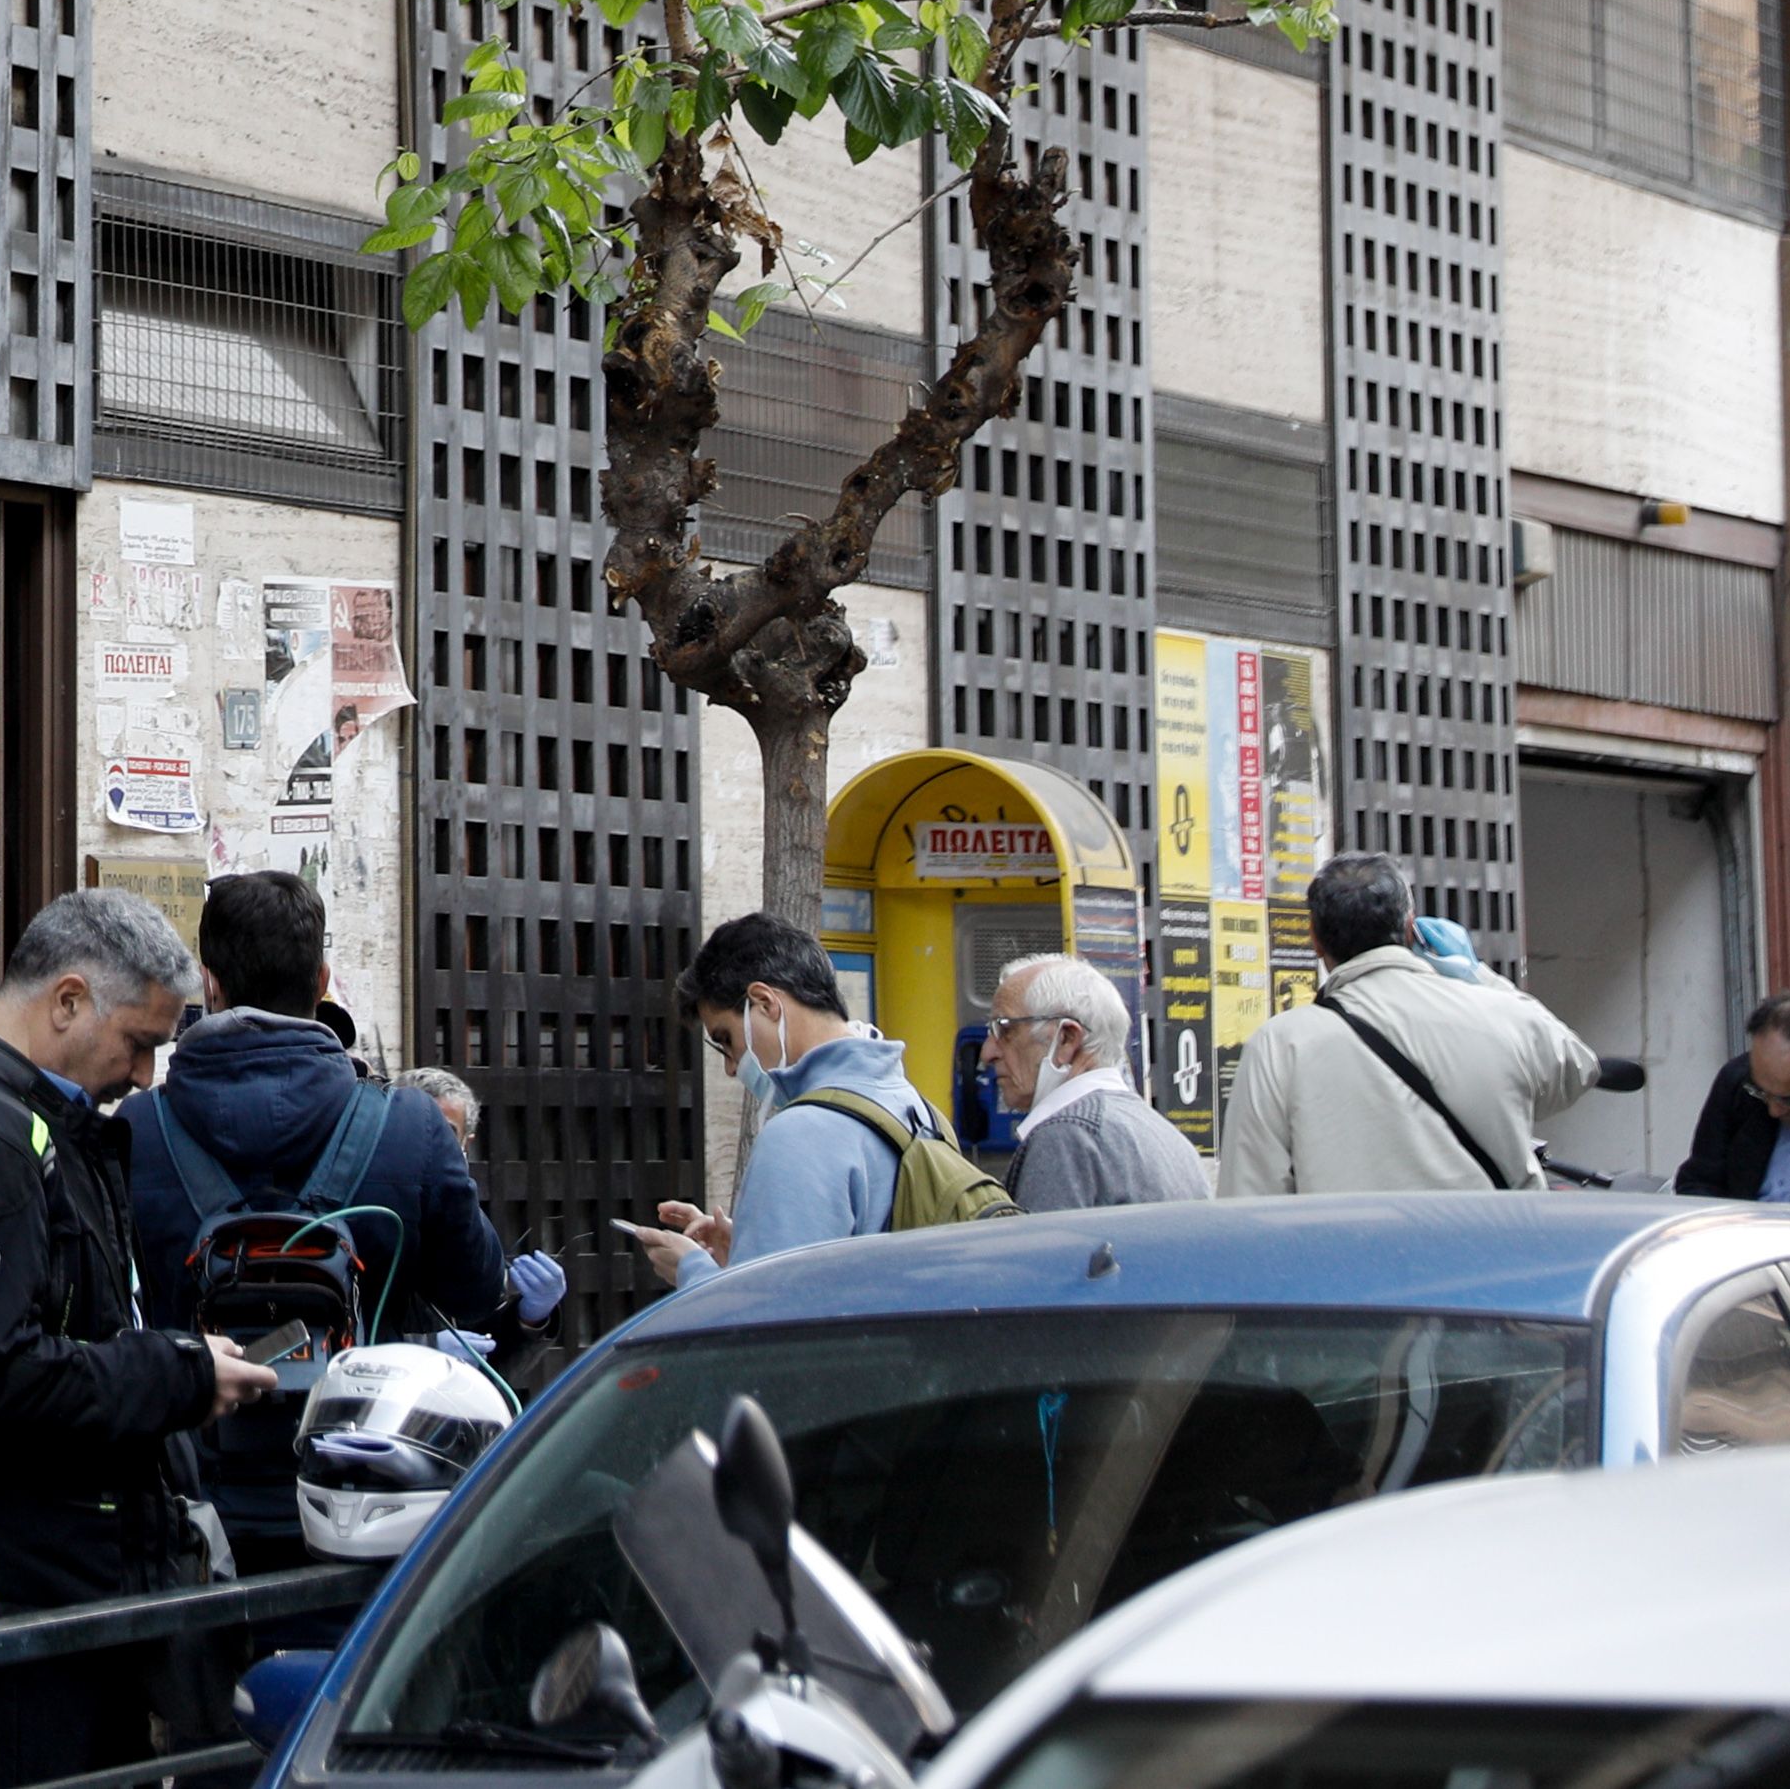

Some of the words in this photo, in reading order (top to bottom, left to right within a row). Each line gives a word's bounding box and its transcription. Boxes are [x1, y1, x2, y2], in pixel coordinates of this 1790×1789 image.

[104, 654, 172, 675] ΠΩΛΕΙΤΑΙ
[233, 704, 256, 736] 175
[929, 829, 1055, 854] ΠΩΛΕΙΤΑ
